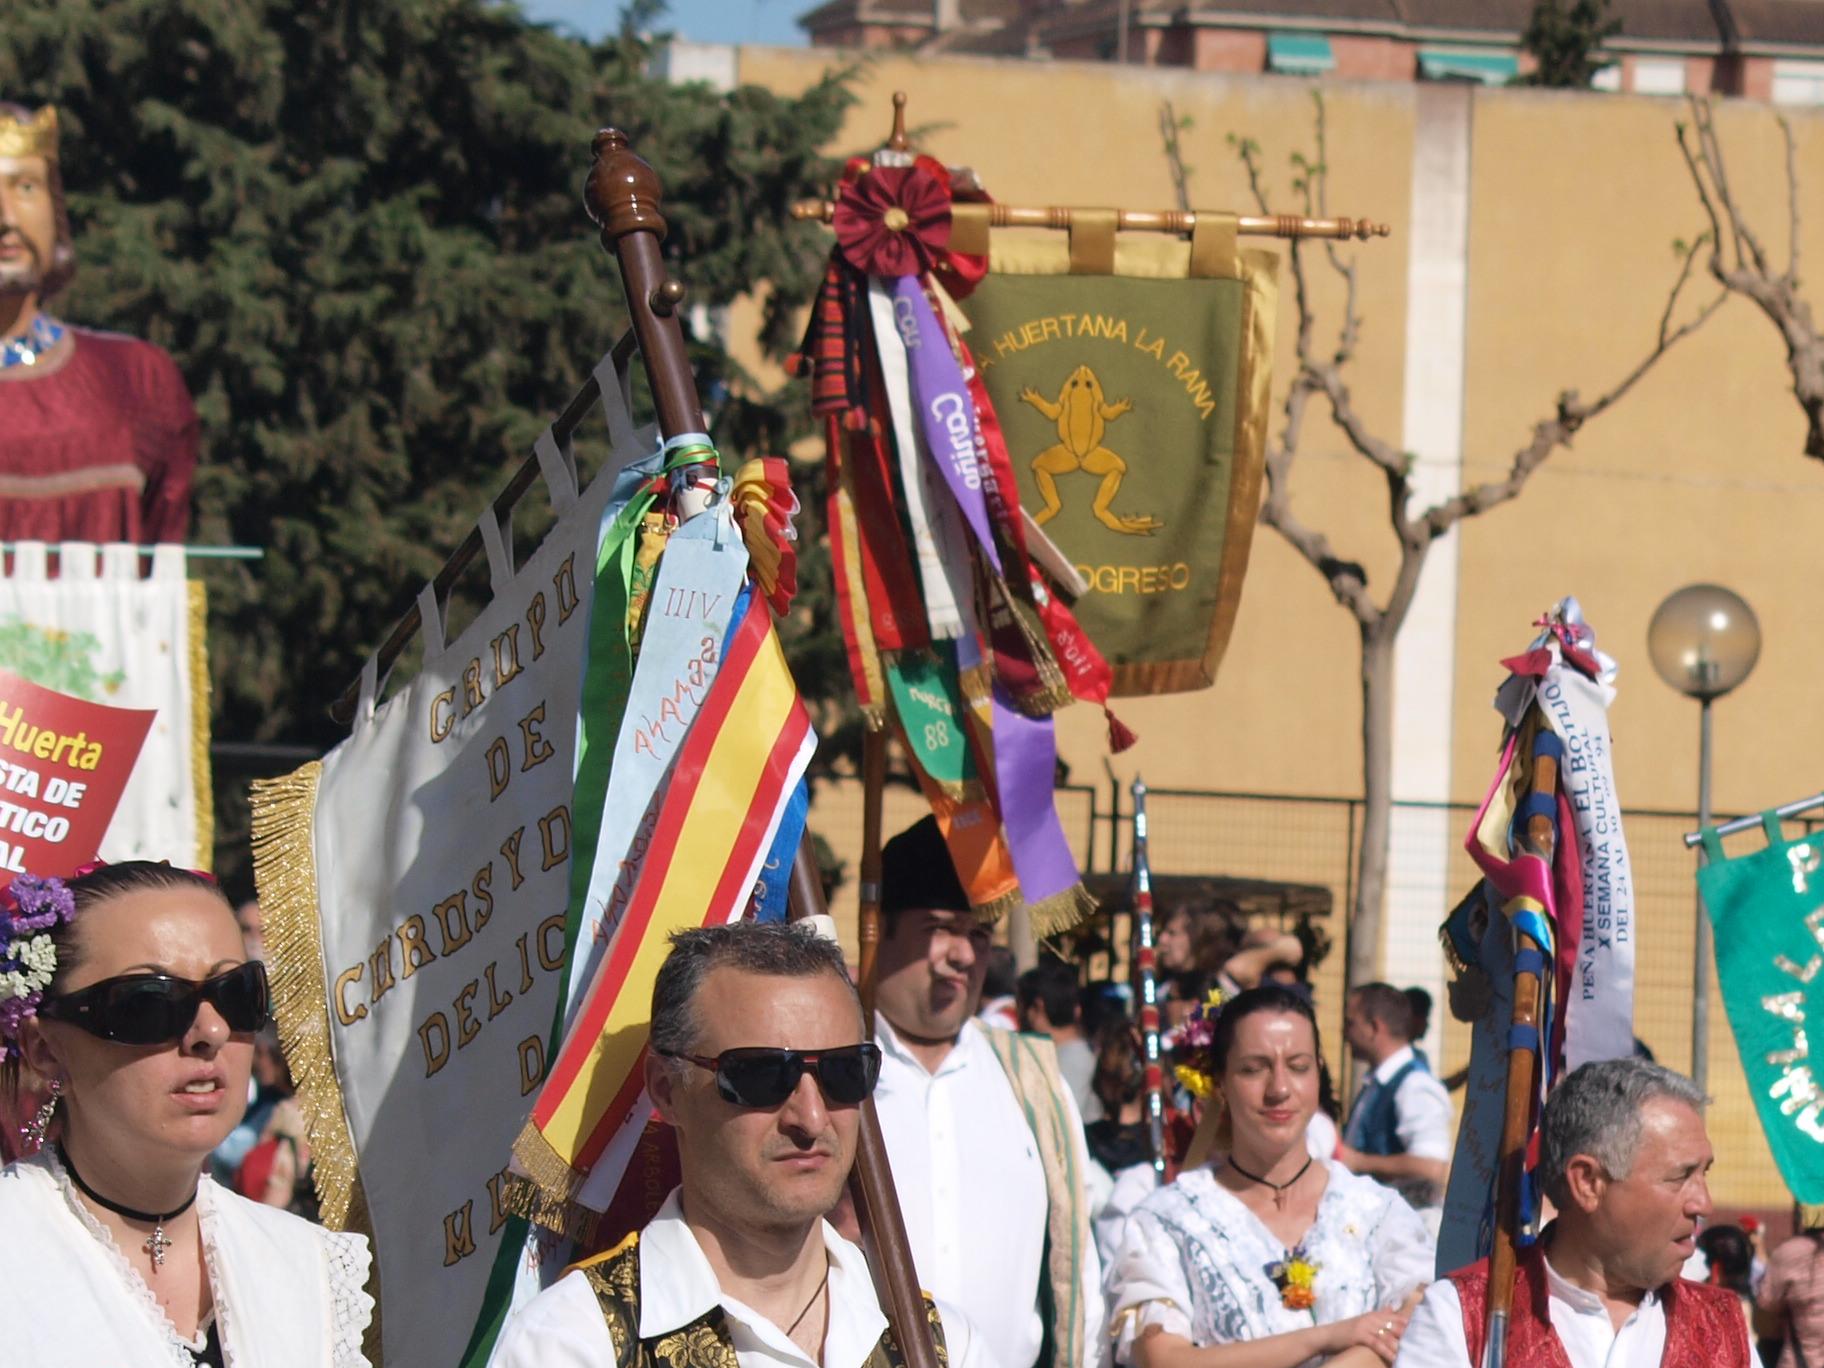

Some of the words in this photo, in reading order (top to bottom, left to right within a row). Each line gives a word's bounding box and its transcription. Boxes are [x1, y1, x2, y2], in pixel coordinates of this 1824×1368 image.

[993, 313, 1127, 358] HUERTANA
[1134, 328, 1166, 360] LA
[1166, 351, 1217, 420] RANA
[1082, 563, 1190, 594] OGRESO
[429, 552, 581, 743] GRUPO
[0, 701, 103, 771] Huerta
[485, 700, 555, 802] DE
[1544, 684, 1586, 774] BOTIJO
[43, 777, 87, 808] DE
[1573, 781, 1591, 813] EL
[1580, 728, 1609, 834] CULTURAL
[0, 800, 70, 843] TICO
[1596, 842, 1612, 930] SEMANA
[1615, 904, 1629, 942] DEL
[334, 862, 493, 1026] COROS
[1580, 946, 1597, 1000] PEÑA
[1598, 936, 1612, 951] X
[418, 910, 568, 1078] DELIC
[642, 1142, 665, 1221] ARBOLE
